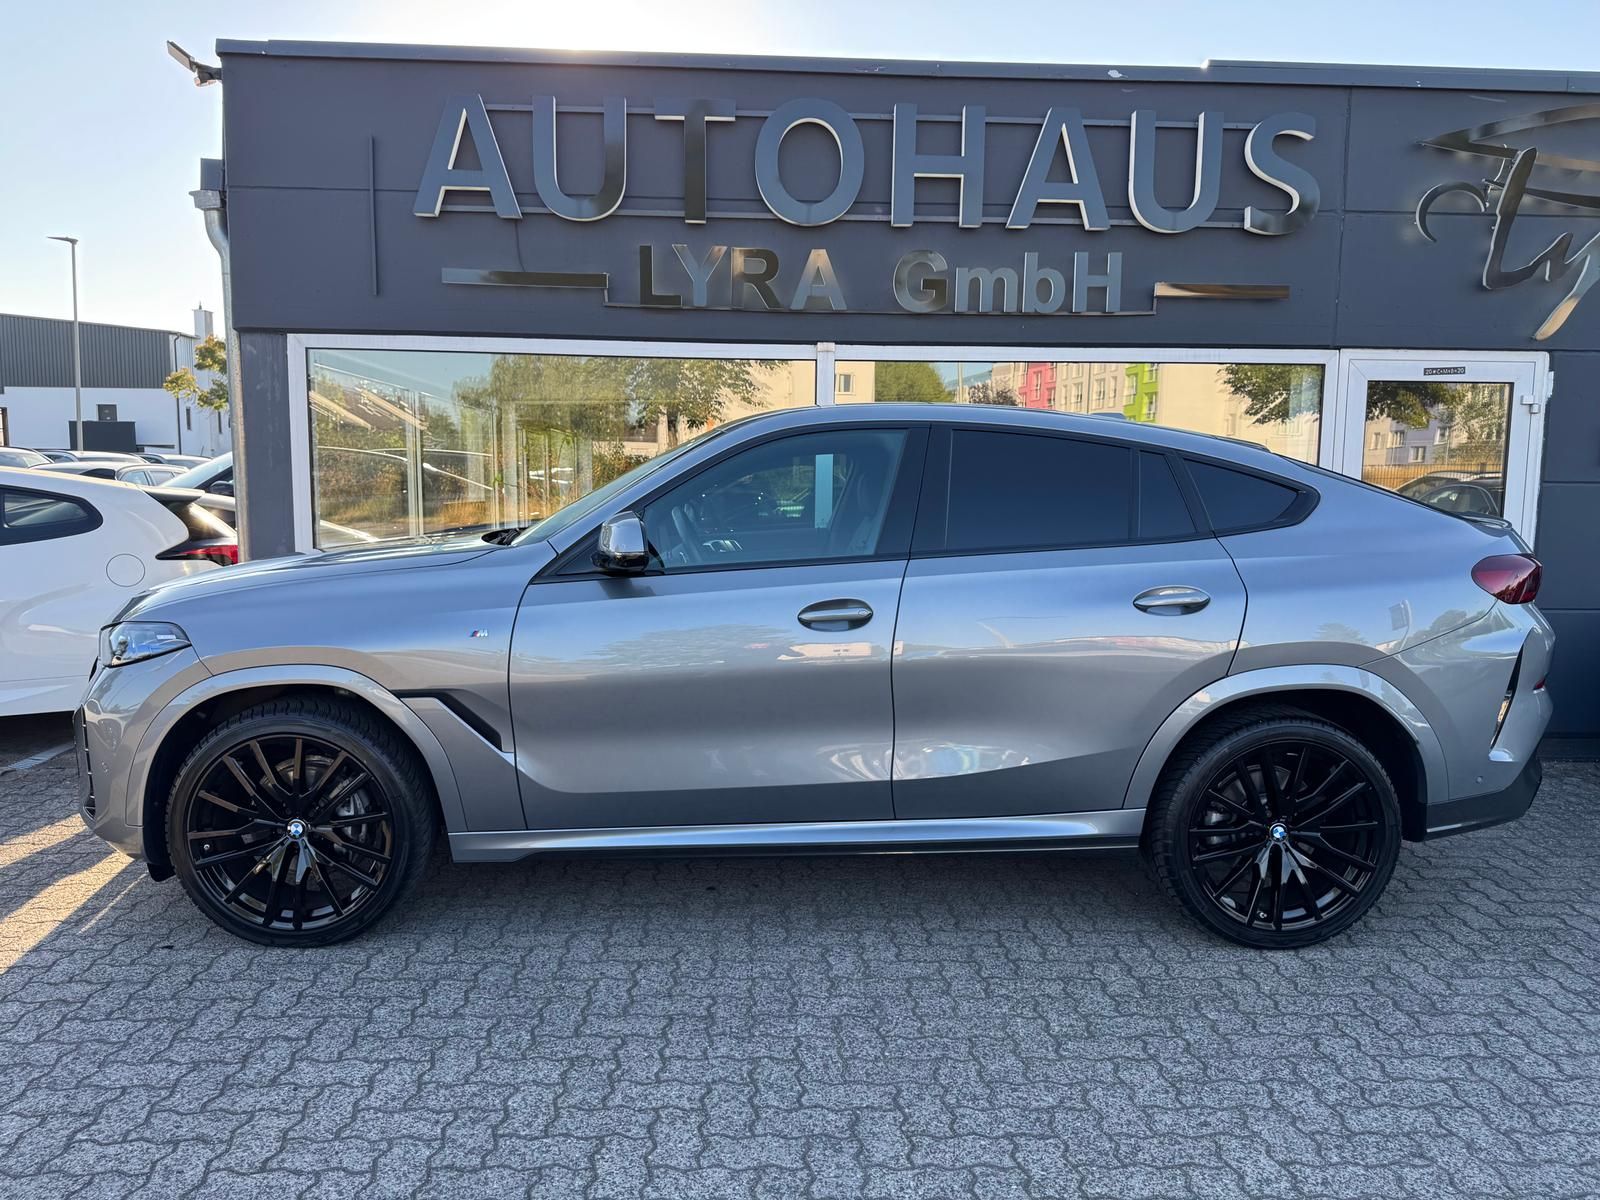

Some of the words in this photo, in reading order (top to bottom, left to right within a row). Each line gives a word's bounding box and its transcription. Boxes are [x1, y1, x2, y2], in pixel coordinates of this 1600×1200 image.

[413, 93, 1321, 236] AUTOHAUS
[638, 243, 848, 310] LYRA
[892, 249, 1122, 314] GmbH
